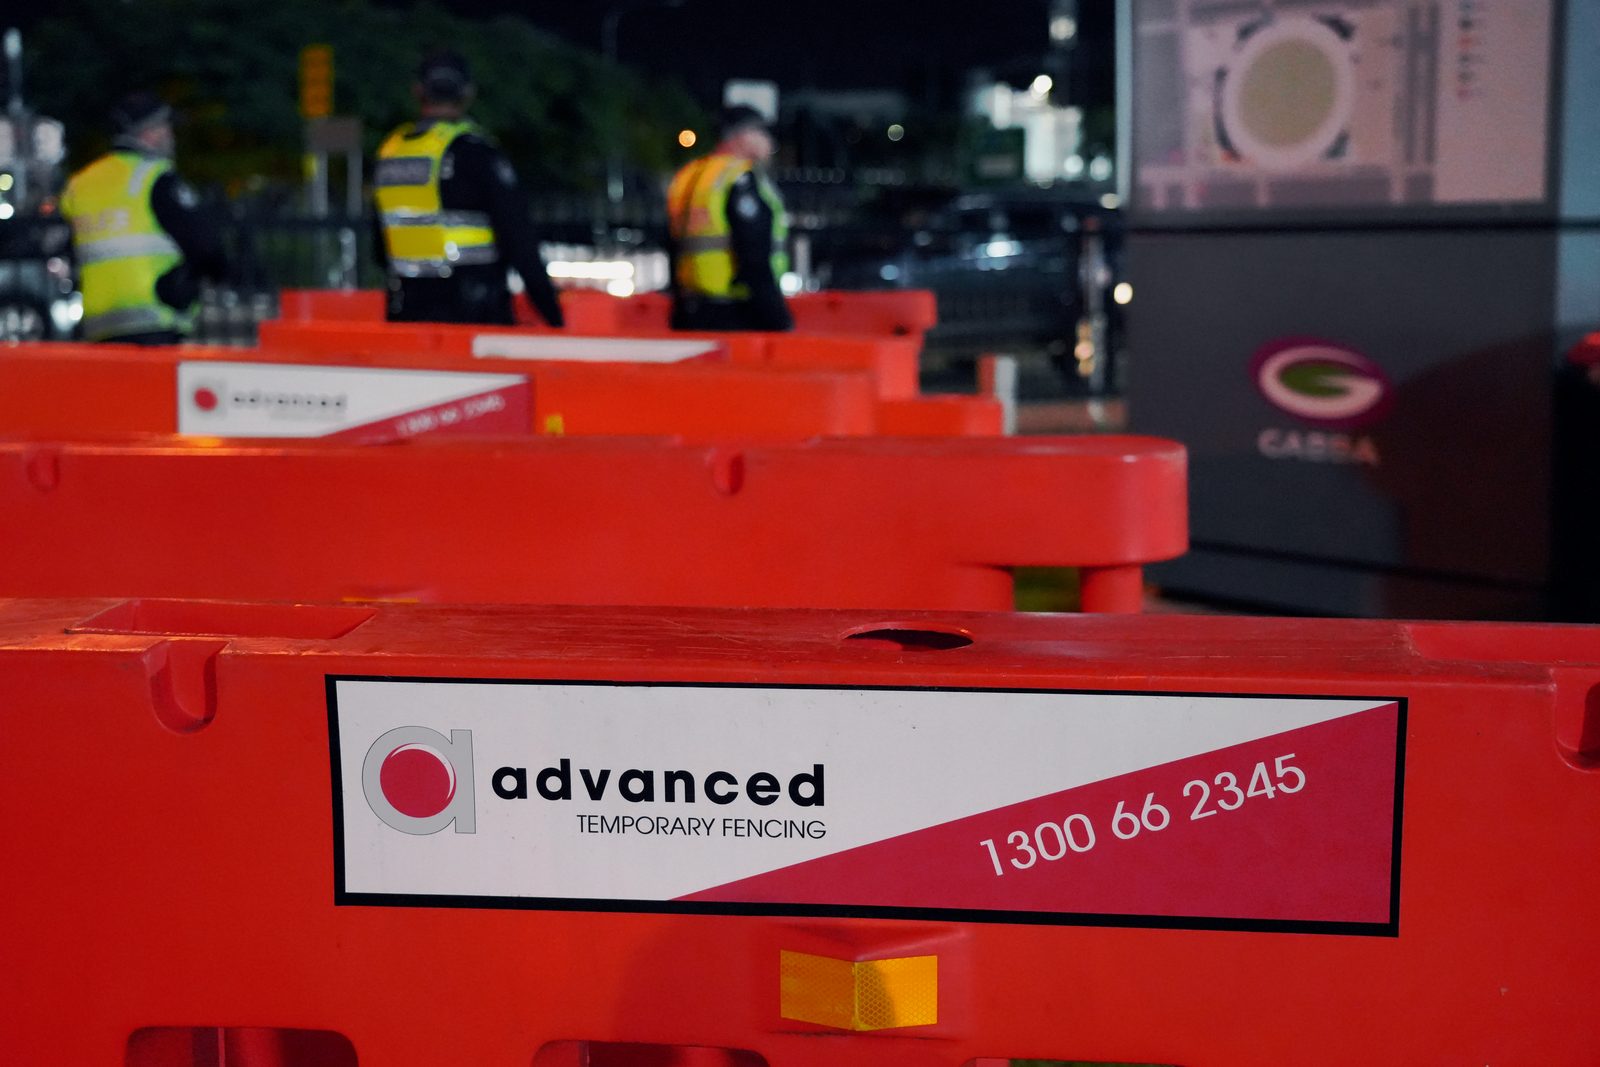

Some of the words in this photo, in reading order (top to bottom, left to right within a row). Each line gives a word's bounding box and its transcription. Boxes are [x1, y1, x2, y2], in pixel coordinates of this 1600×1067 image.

[491, 758, 825, 807] advanced
[576, 814, 715, 837] TEMPORARY
[722, 818, 827, 840] FENCING
[980, 813, 1096, 876] 1300
[1111, 792, 1171, 840] 66
[1182, 753, 1306, 821] 2345
